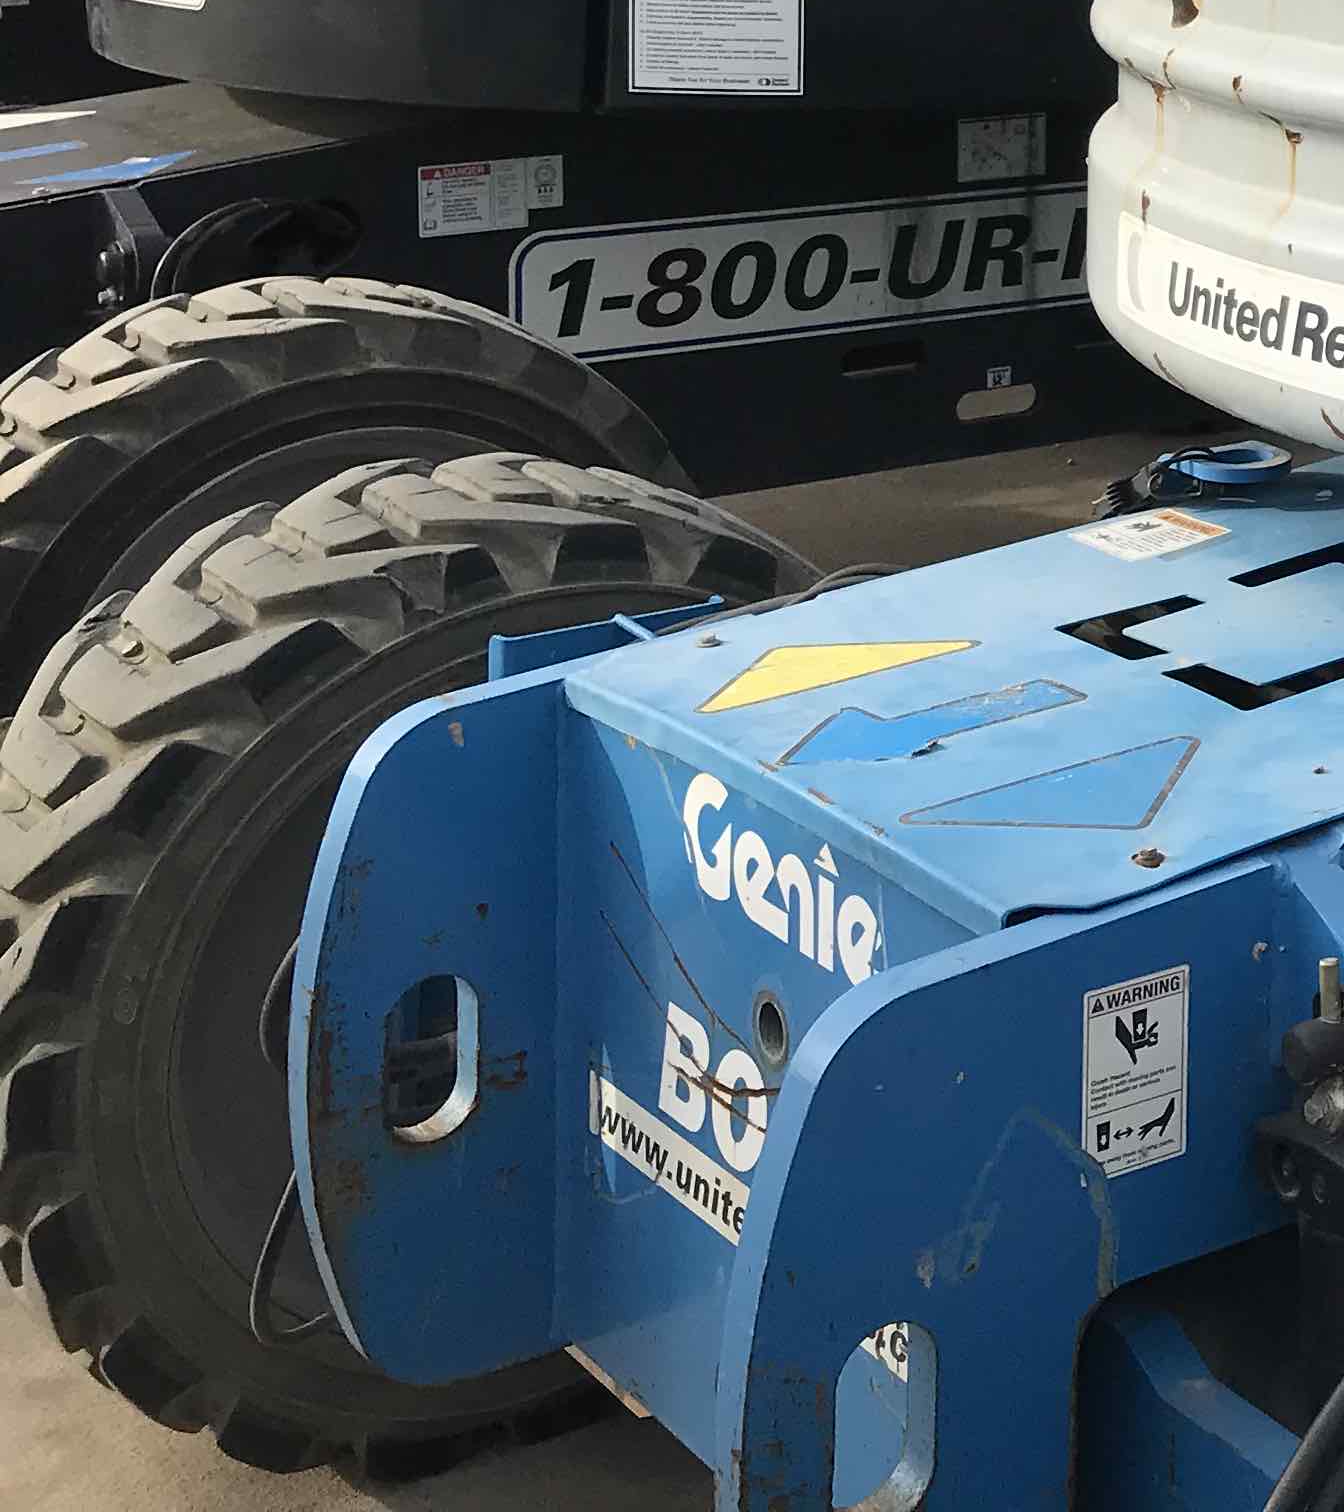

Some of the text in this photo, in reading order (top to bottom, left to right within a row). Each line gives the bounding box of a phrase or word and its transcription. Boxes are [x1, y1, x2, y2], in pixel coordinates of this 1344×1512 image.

[444, 166, 485, 178] DANGER
[1168, 261, 1290, 351] United
[682, 772, 882, 988] Genie
[1106, 975, 1181, 1010] WARNING
